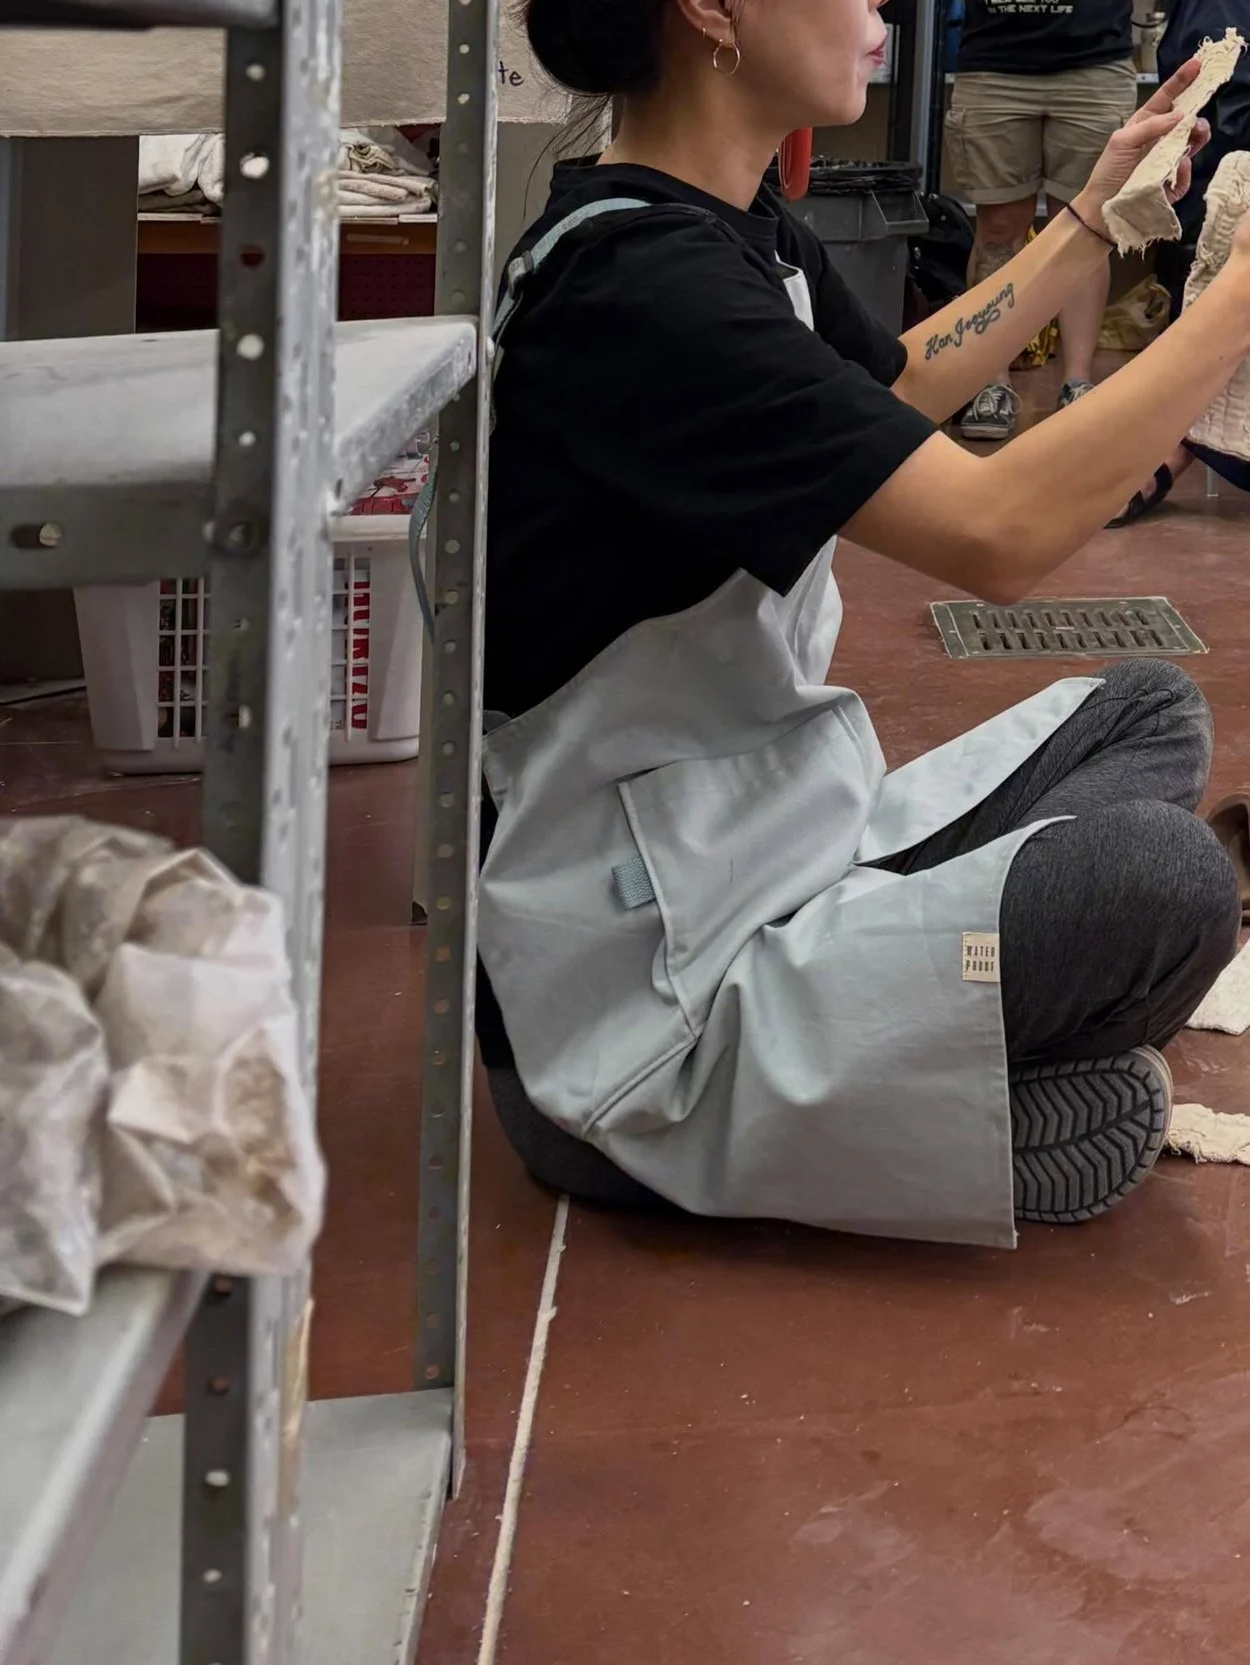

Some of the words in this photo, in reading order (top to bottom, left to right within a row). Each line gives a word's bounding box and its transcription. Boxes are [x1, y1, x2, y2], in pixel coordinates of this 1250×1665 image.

[997, 4, 1016, 13] THE
[1019, 4, 1048, 13] NEXT
[1050, 5, 1073, 13] LIFE
